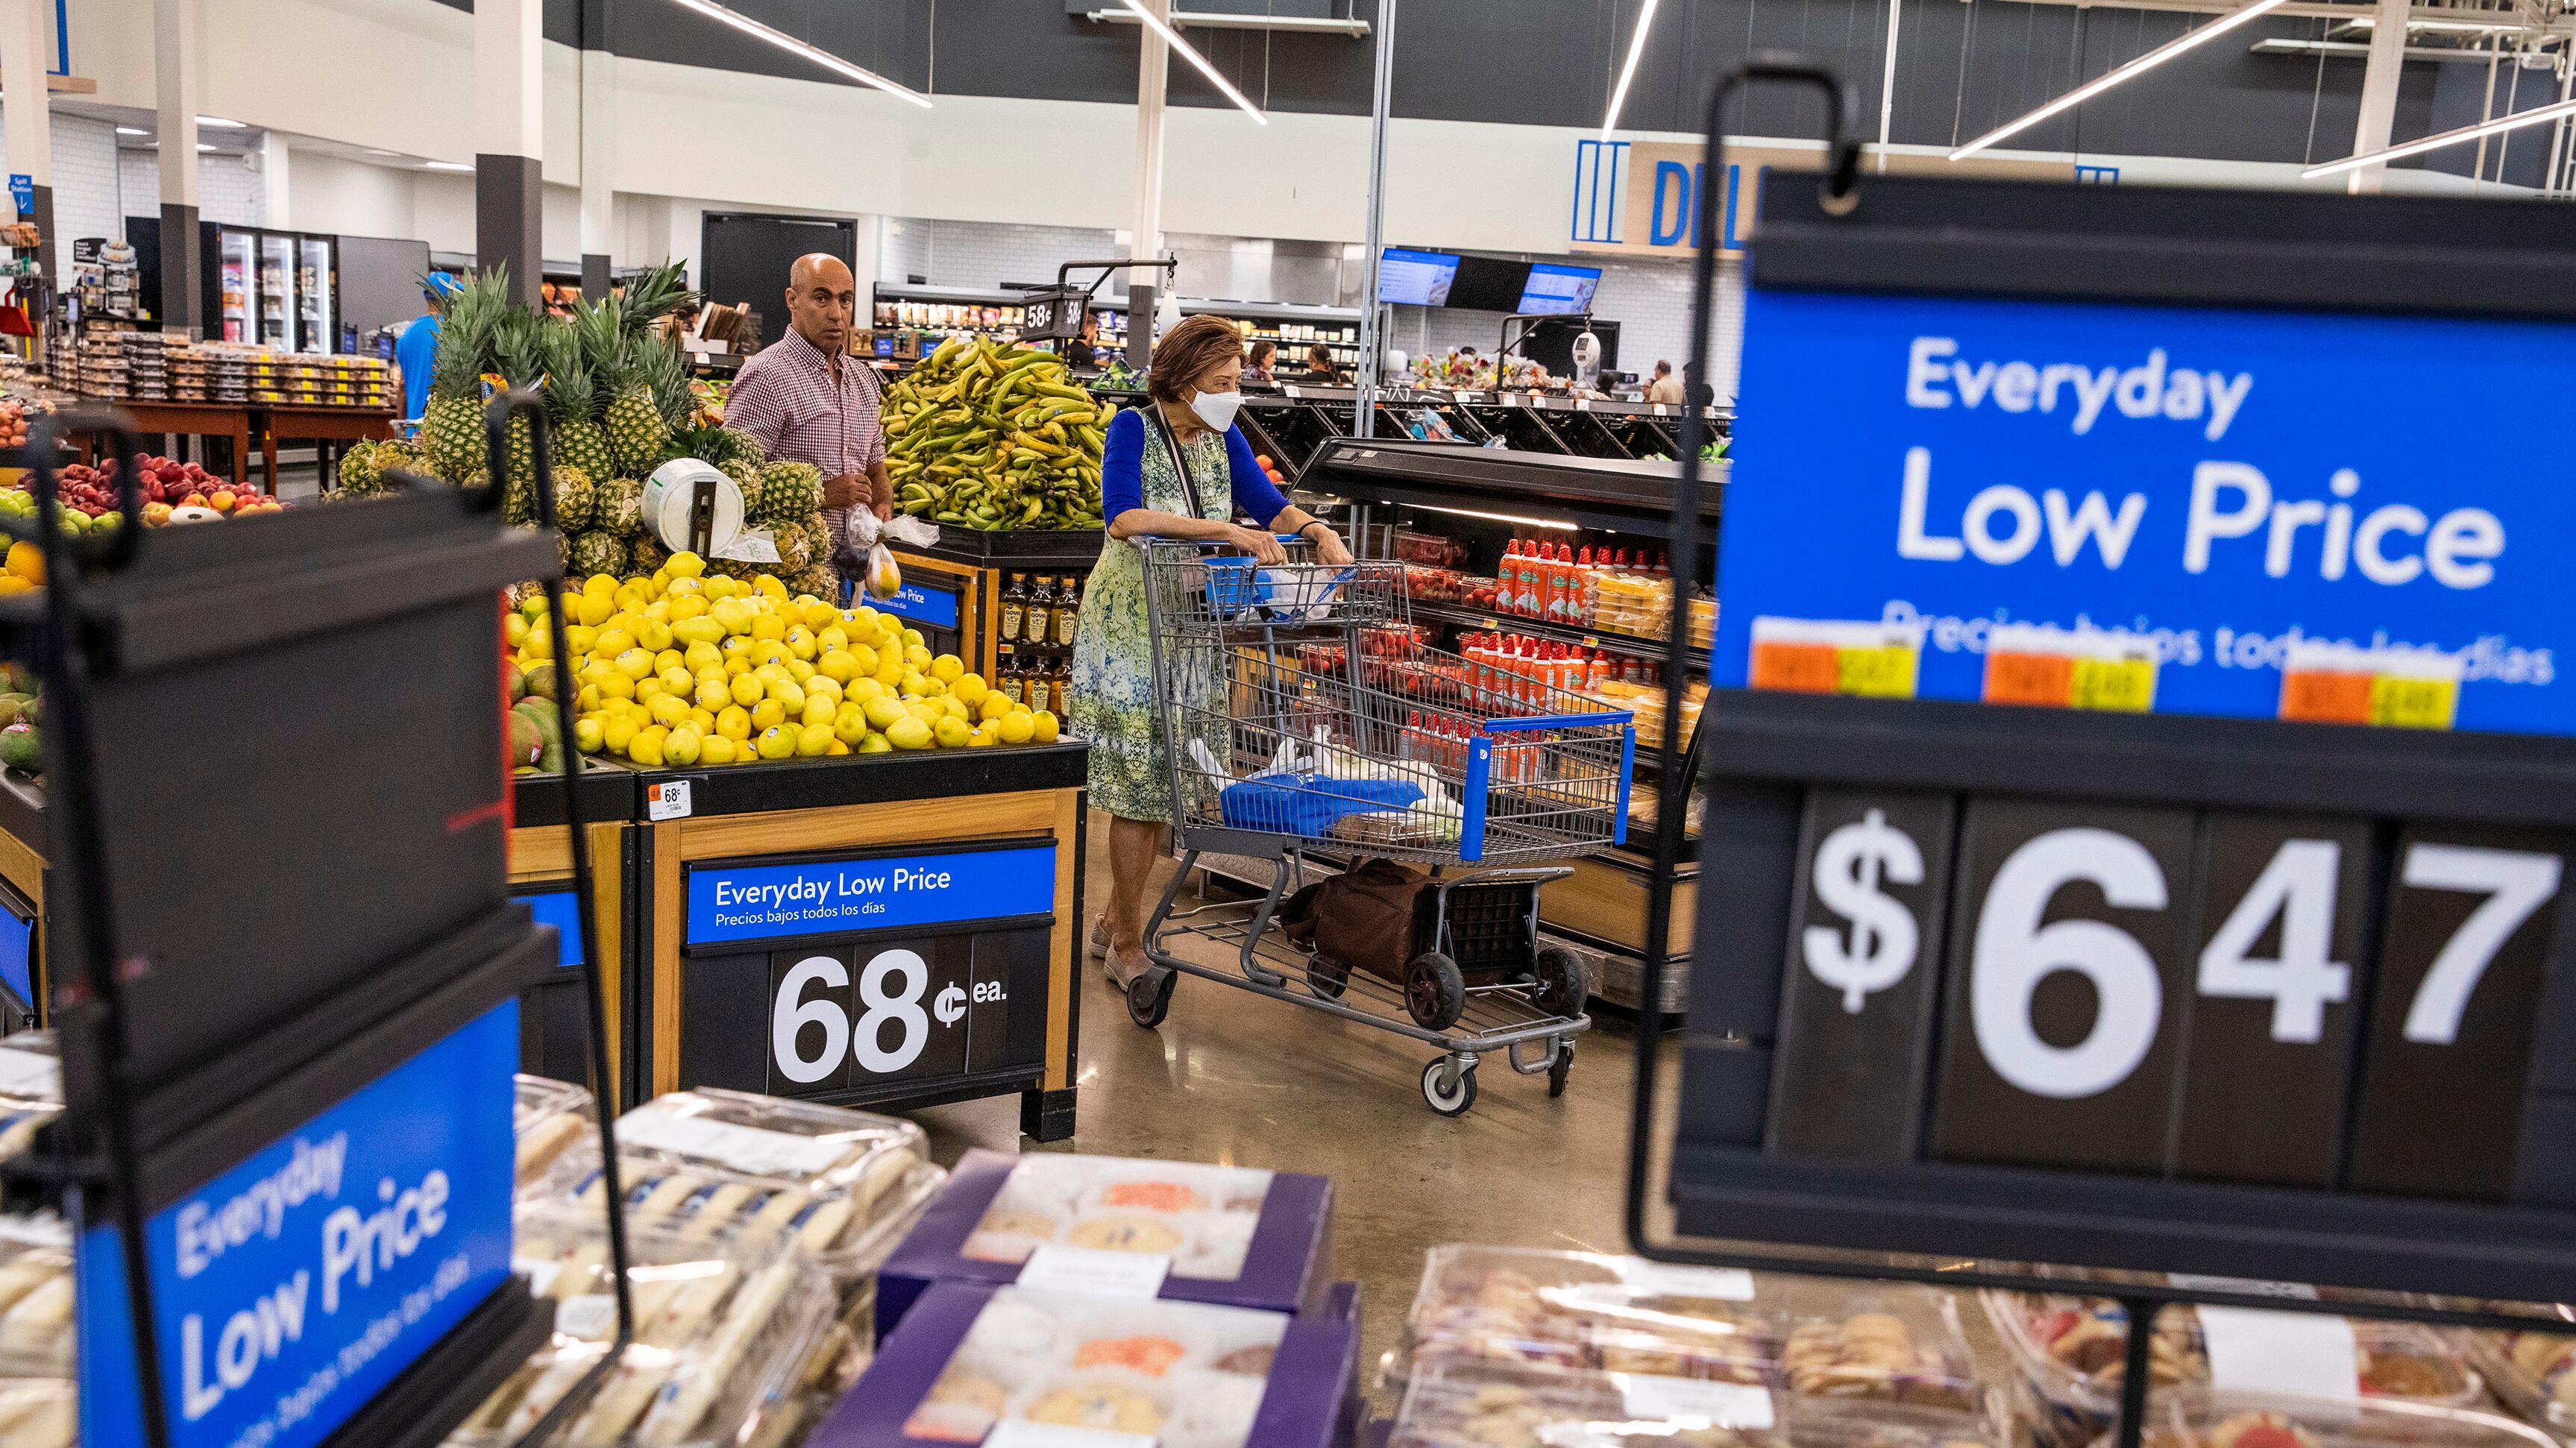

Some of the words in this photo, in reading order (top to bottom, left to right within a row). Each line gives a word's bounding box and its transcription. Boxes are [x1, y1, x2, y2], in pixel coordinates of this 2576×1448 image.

[10, 184, 33, 192] Station
[14, 177, 28, 185] Spill
[1905, 336, 2252, 441] Everyday
[1897, 446, 2146, 570] Low
[2182, 459, 2507, 590] Price
[894, 589, 907, 599] ow
[908, 588, 925, 604] Price
[665, 787, 681, 803] 68¢
[716, 875, 831, 908] Everyday
[839, 872, 885, 896] Low
[893, 866, 951, 892] Price
[716, 910, 764, 927] Precios
[767, 908, 799, 925] bajos
[802, 905, 838, 919] todos
[841, 904, 858, 916] los
[861, 901, 885, 914] días
[973, 980, 1007, 1004] ea.
[176, 1131, 348, 1279] Everyday
[181, 1268, 310, 1421] Low
[321, 1168, 450, 1315] Price
